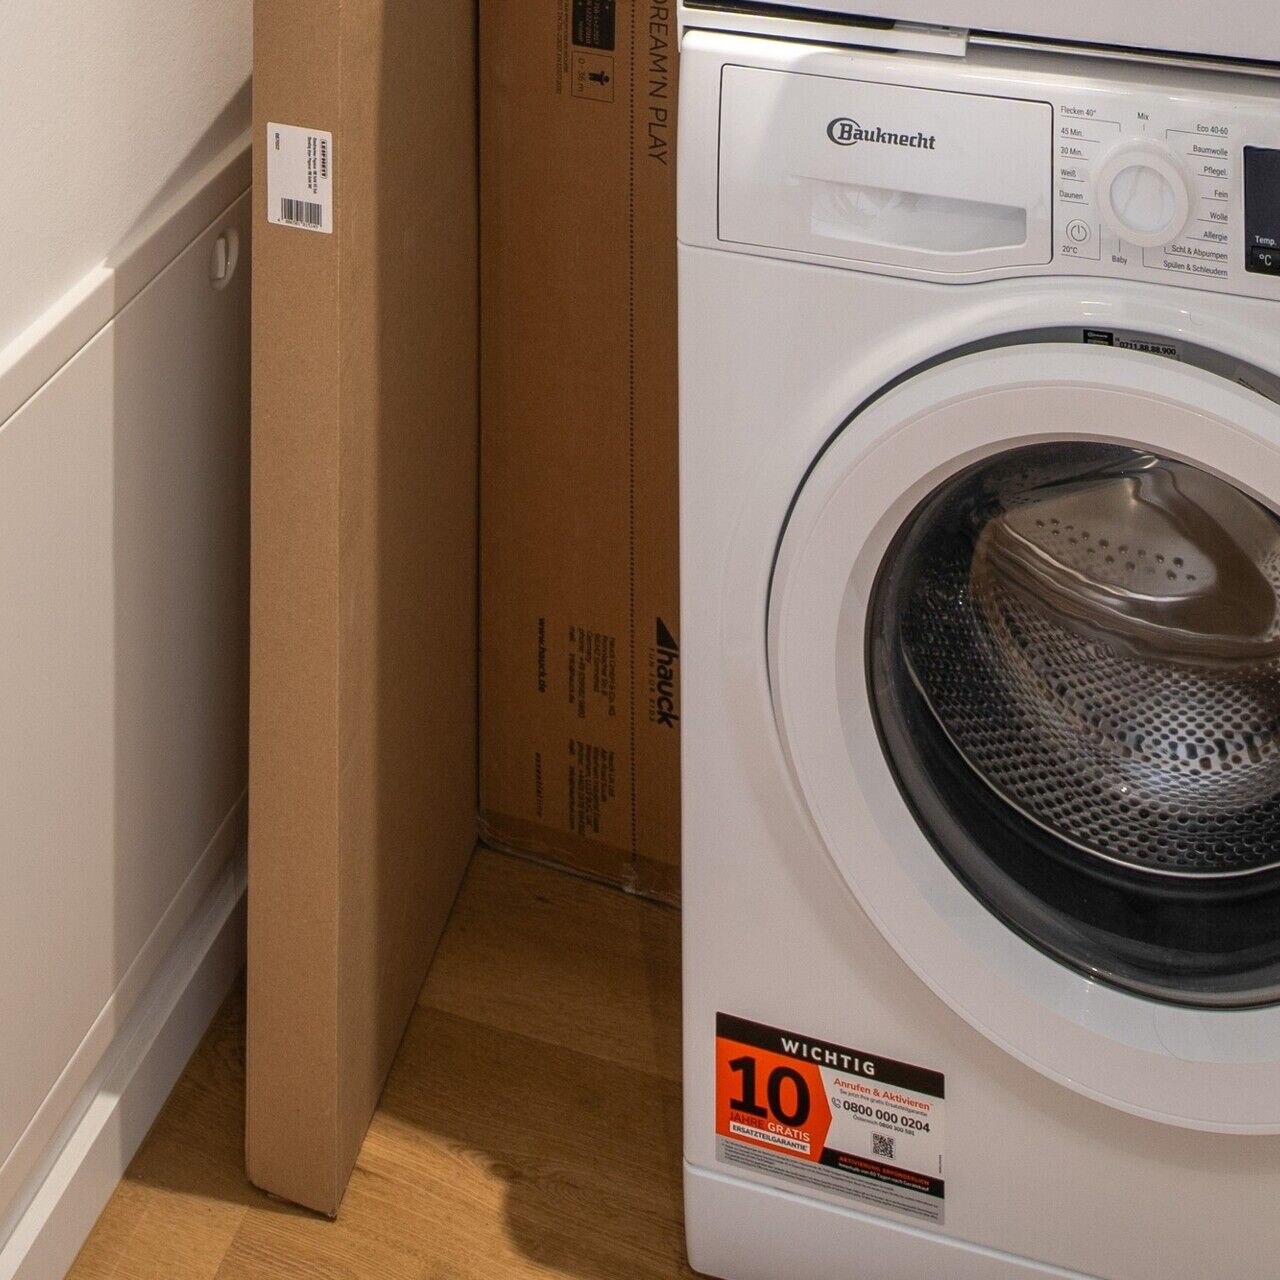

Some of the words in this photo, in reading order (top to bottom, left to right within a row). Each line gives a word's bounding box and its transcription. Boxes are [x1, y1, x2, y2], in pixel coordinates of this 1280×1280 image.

[1060, 105, 1084, 116] Flecken
[1085, 109, 1097, 117] 40°
[1137, 112, 1150, 120] Mix
[826, 117, 936, 150] Bauknecht
[1060, 127, 1069, 135] 45
[1070, 128, 1084, 137] Min.
[1197, 124, 1209, 133] Eco
[1210, 126, 1229, 135] 40-60
[648, 106, 669, 166] PLAY
[1060, 146, 1069, 155] 30
[1192, 144, 1229, 157] Baumwolle
[1060, 168, 1077, 177] Weiß
[1203, 165, 1228, 177] Pflegel.
[1059, 189, 1084, 200] Daunen
[1214, 189, 1229, 198] Fein
[1209, 211, 1229, 221] Wolle
[1203, 231, 1229, 242] Allergie
[1254, 235, 1277, 246] Temp.
[1062, 245, 1079, 254] 20°C
[1187, 247, 1192, 255] &
[1193, 248, 1229, 260] Abpumpen
[1111, 254, 1128, 265] Baby
[1258, 253, 1272, 266] °C
[1163, 259, 1185, 270] Spülen
[1186, 263, 1191, 271] &
[1192, 264, 1229, 276] Schleudern
[656, 647, 680, 729] hauck
[780, 1037, 876, 1076] WICHTIG
[728, 1055, 811, 1127] 10
[833, 1077, 871, 1095] Anrufen
[872, 1087, 880, 1097] &
[843, 1100, 873, 1117] 0800
[875, 1109, 898, 1124] 000
[900, 1116, 930, 1133] 0204
[730, 1111, 764, 1128] JAHRE
[767, 1122, 811, 1142] GRATIS
